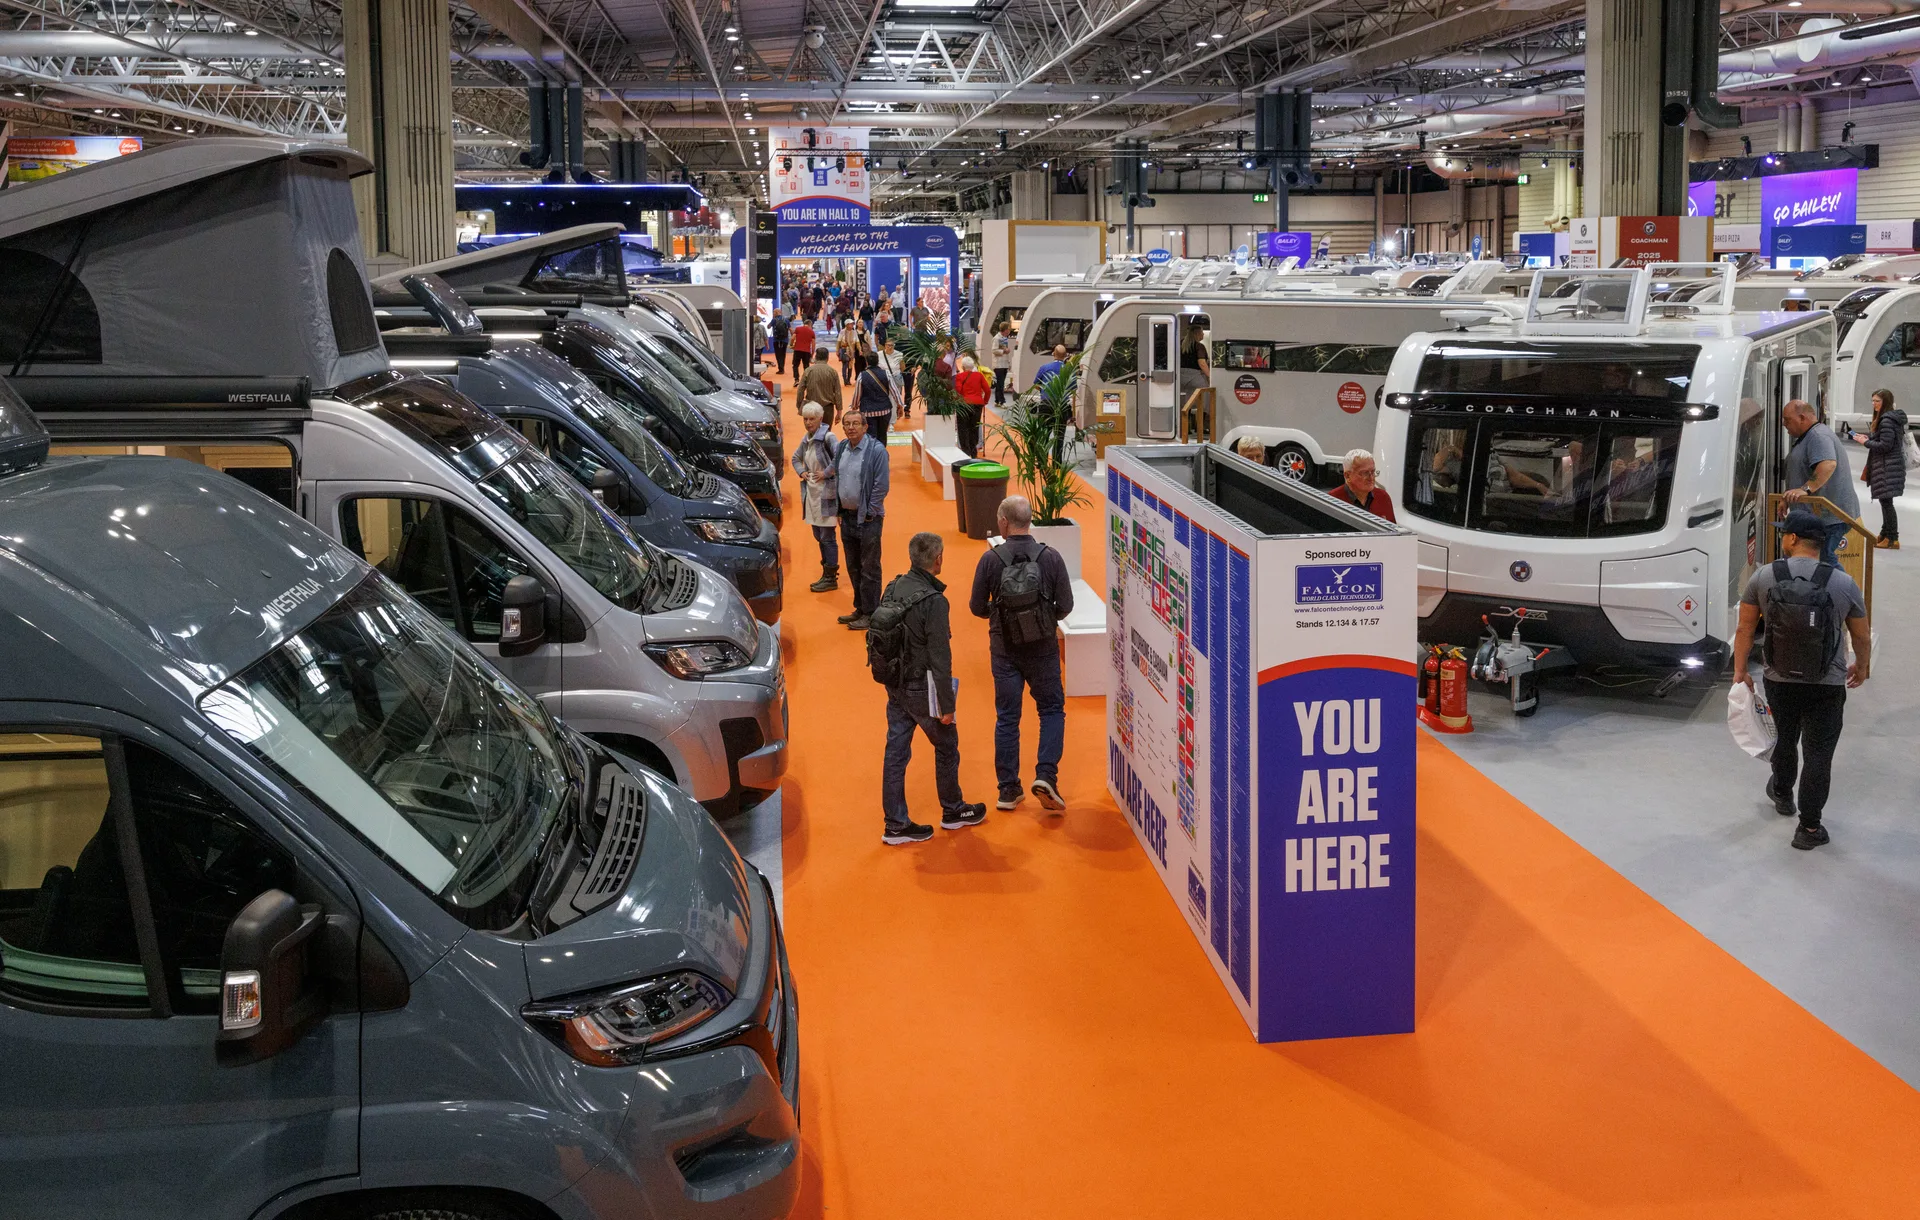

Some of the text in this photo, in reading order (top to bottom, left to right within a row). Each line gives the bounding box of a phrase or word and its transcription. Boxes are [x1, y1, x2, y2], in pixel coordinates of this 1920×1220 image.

[1713, 192, 1736, 218] ar
[1774, 192, 1842, 225] GO BAILEY!
[782, 208, 860, 220] YOU ARE IN HALL 19
[800, 233, 850, 243] WELCOME
[870, 231, 889, 240] THE
[1881, 231, 1891, 240] BAR
[792, 241, 899, 255] NATION'S FAVOURITE
[228, 394, 292, 402] WESTFALIA
[1466, 405, 1619, 418] COACHMAN
[1305, 549, 1371, 561] Sponsored by
[1302, 584, 1376, 595] FALCON
[263, 578, 324, 619] WESTFALIA
[1293, 698, 1380, 756] YOU
[1296, 767, 1378, 824] ARE
[1109, 736, 1167, 870] YOU ARE HERE
[1285, 834, 1390, 893] HERE
